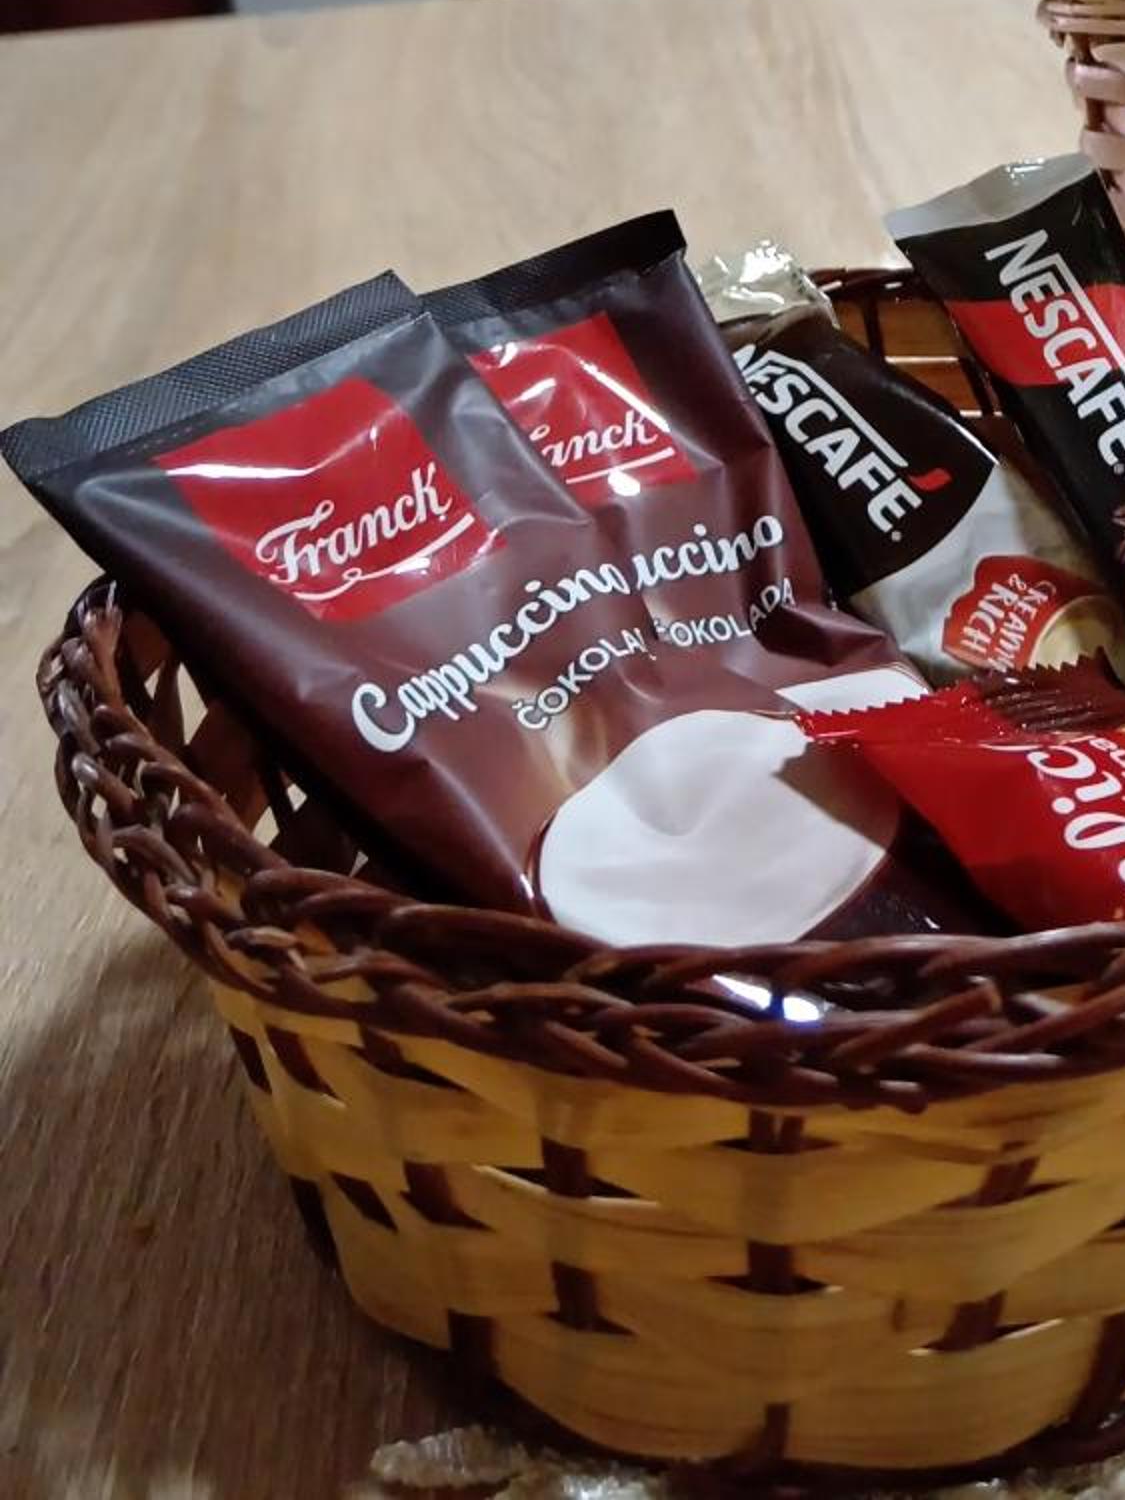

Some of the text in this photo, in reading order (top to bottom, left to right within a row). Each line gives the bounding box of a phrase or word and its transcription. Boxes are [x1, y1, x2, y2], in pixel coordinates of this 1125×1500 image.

[256, 461, 452, 583] Franck
[352, 563, 630, 752] Cappuccino
[960, 582, 1020, 654] RICH
[512, 627, 652, 730] ČOKOLA
